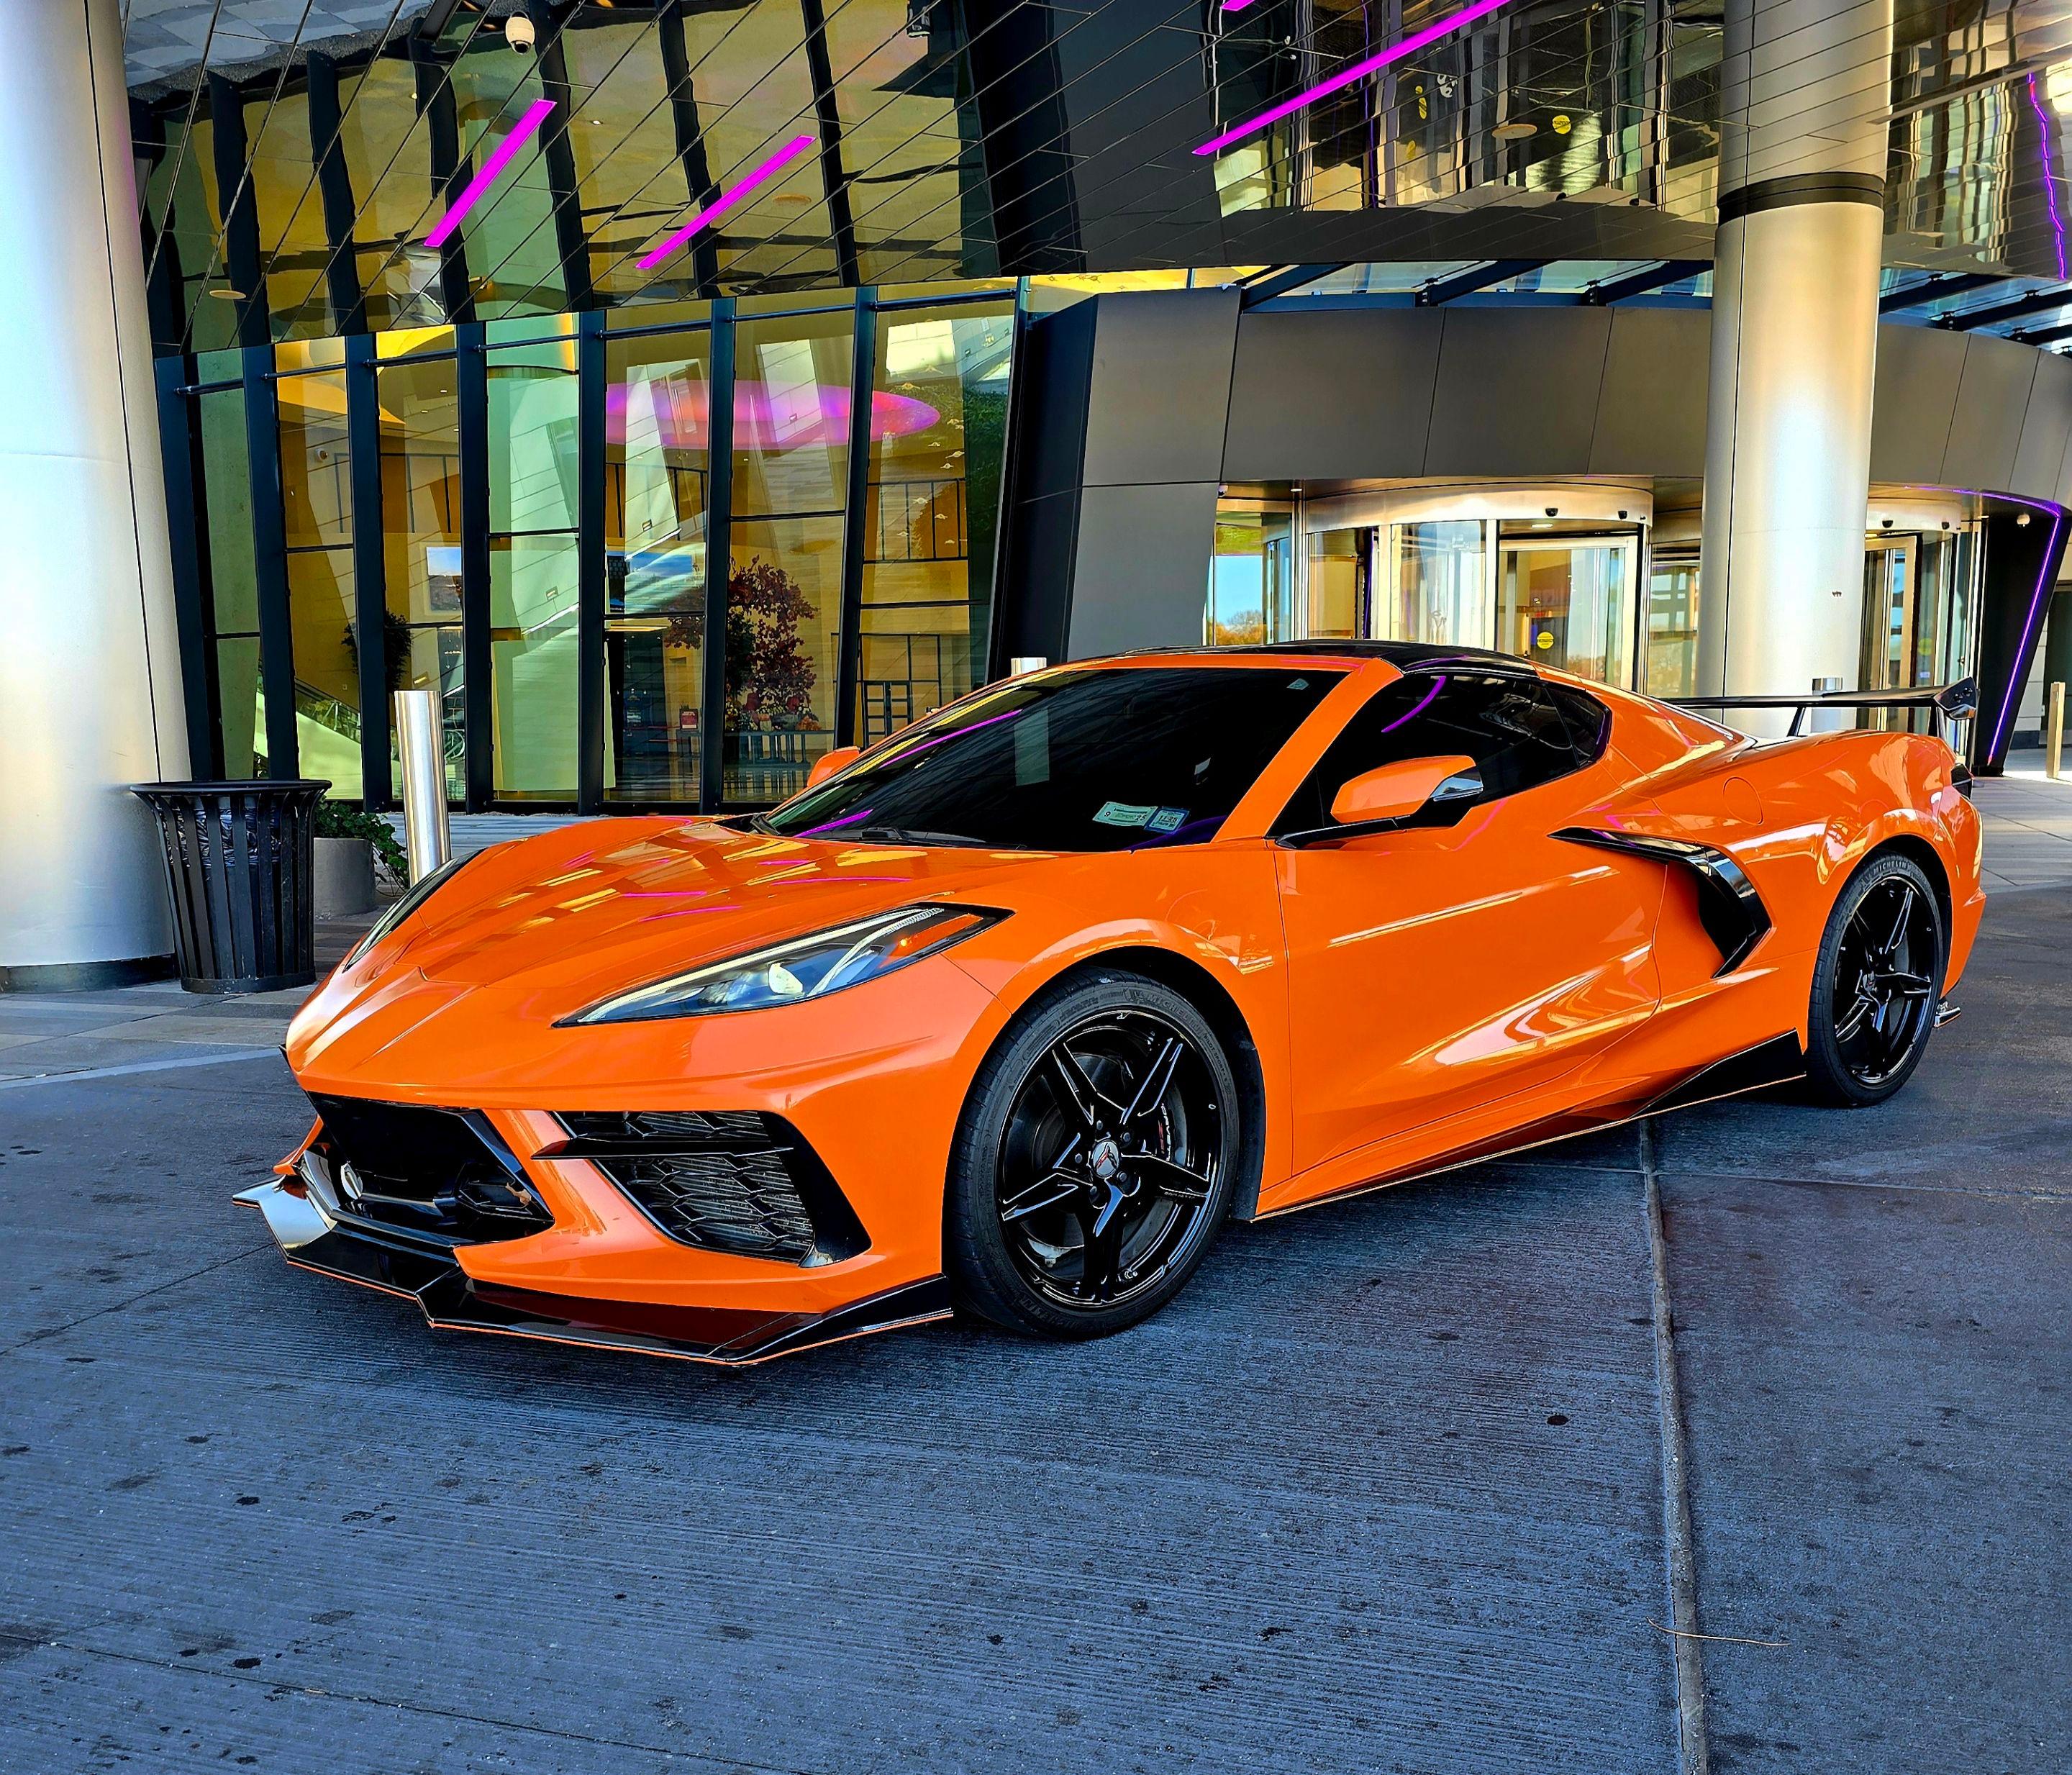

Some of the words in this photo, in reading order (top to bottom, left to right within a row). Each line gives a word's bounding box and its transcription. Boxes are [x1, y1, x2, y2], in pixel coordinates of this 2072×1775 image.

[1873, 861, 1907, 874] MICHELIN
[1146, 993, 1203, 1035] MICHELIN
[1204, 1035, 1215, 1050] PILOT
[1214, 1053, 1224, 1071] SPORT
